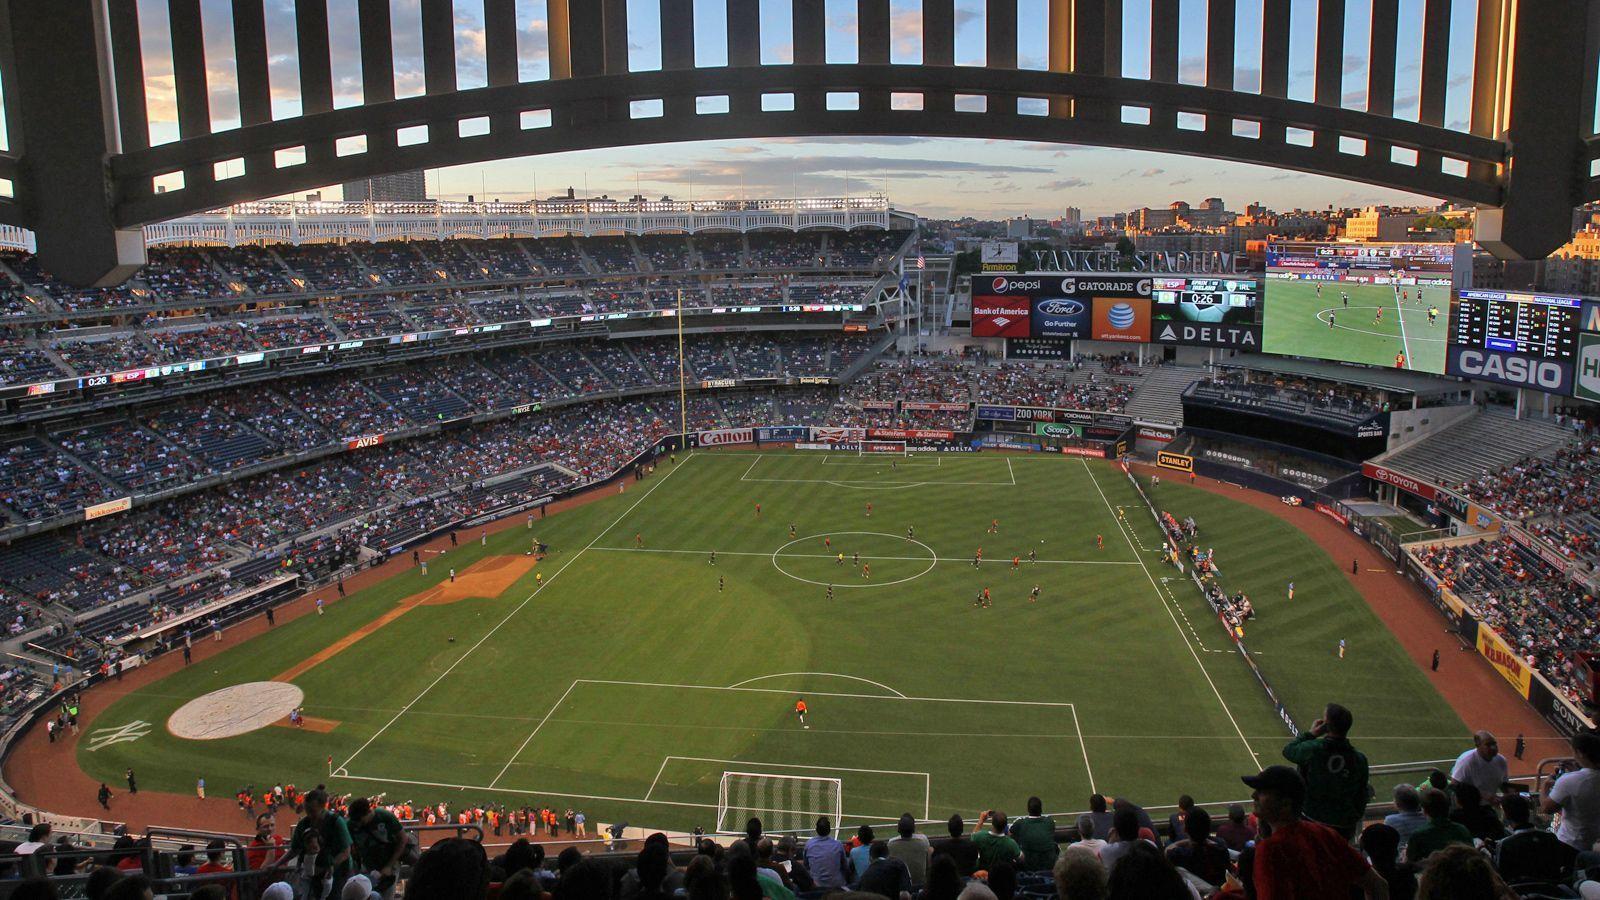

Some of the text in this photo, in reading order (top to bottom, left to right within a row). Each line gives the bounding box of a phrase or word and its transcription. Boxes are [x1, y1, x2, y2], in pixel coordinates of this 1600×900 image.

[982, 263, 1016, 271] Armitron
[1035, 250, 1120, 272] YANKEE
[1132, 250, 1240, 274] STADIUM
[1009, 281, 1041, 291] pepsi
[1078, 282, 1134, 291] GATORADE
[1191, 293, 1213, 304] 0:26
[1046, 301, 1075, 314] Ford
[1183, 326, 1255, 345] DELTA
[1459, 350, 1562, 389] CASIO
[1016, 409, 1032, 419] ZOO
[1032, 410, 1053, 420] YORK
[1063, 412, 1092, 420] YOKOHAMA
[1047, 426, 1070, 434] Scotts
[356, 436, 379, 448] AVIS
[700, 431, 752, 445] Canon
[1160, 455, 1190, 467] STANLEY
[1388, 473, 1419, 492] TOYOTA
[1552, 699, 1583, 732] SONY
